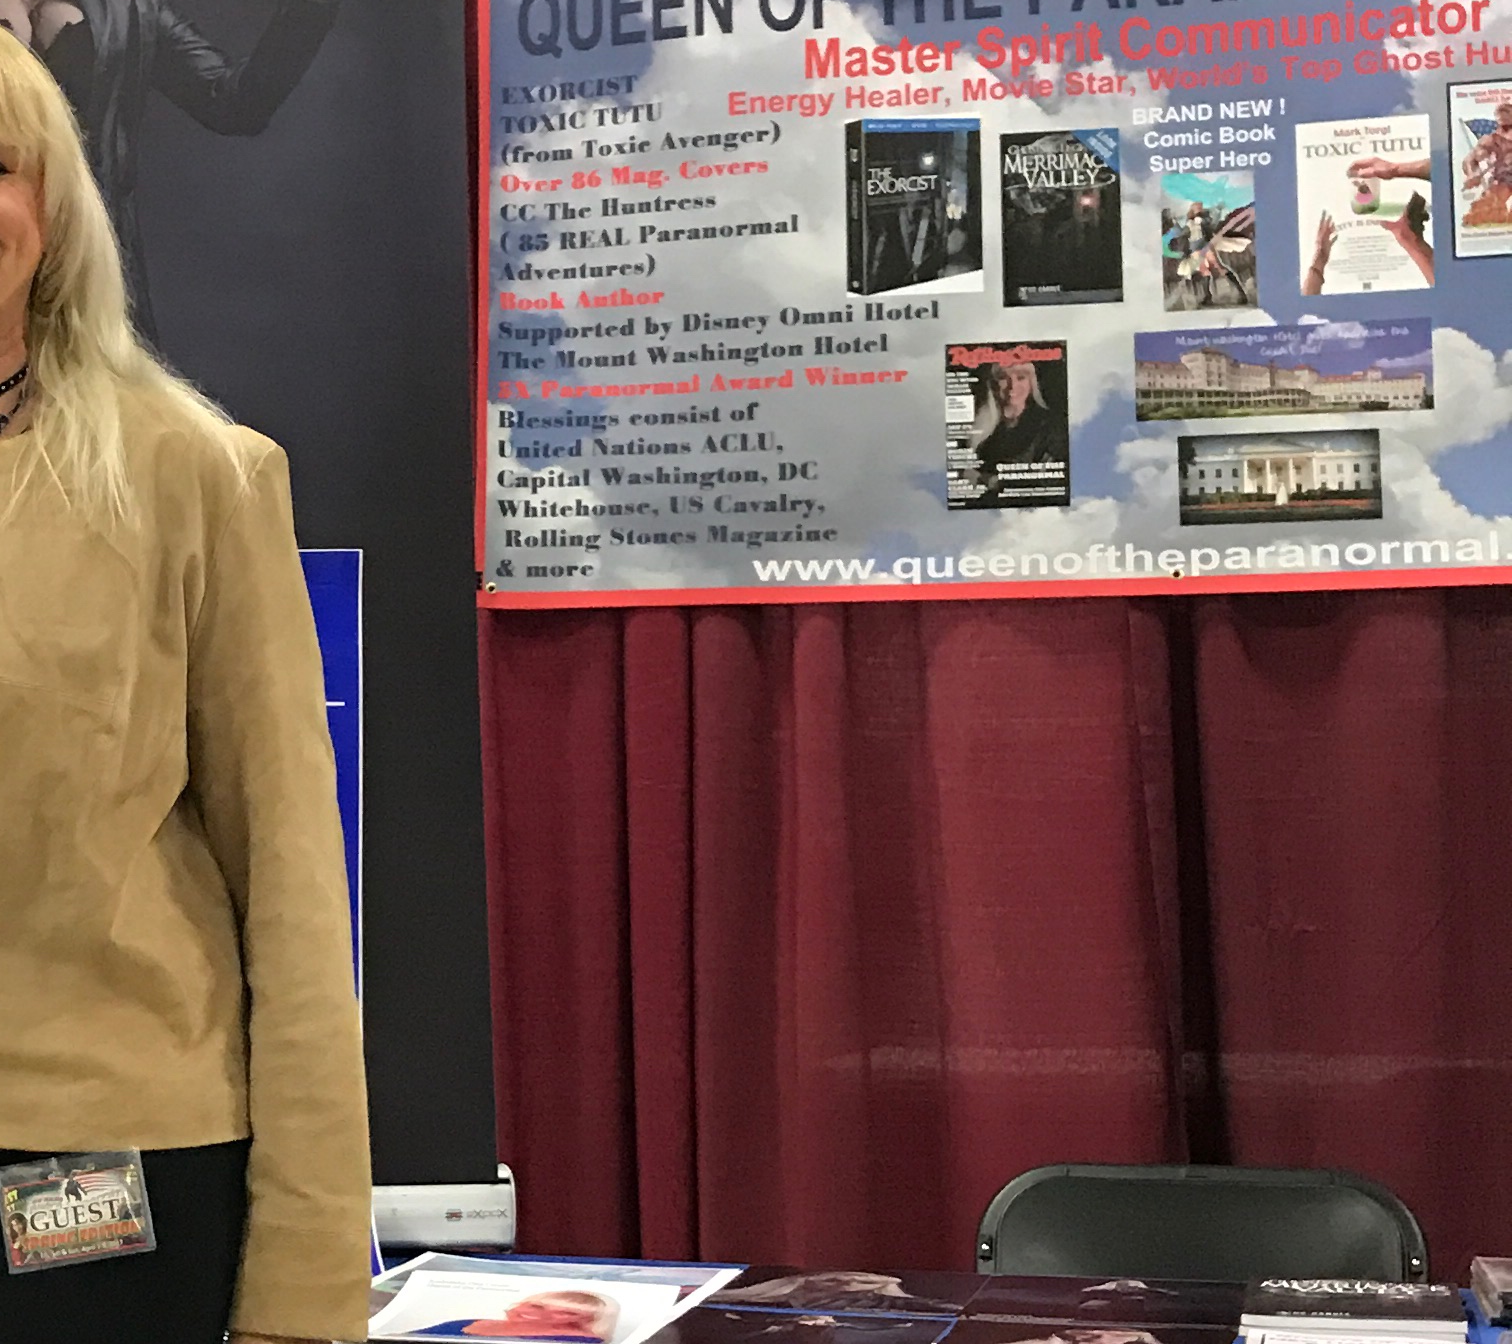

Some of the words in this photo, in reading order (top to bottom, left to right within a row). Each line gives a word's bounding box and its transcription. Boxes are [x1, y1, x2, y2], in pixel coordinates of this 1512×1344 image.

[805, 37, 961, 80] Master
[976, 21, 1103, 75] Spirit
[501, 74, 638, 105] EXORCIST
[728, 91, 834, 118] Energy
[845, 84, 951, 111] Healer,
[962, 77, 1053, 102] Movie
[1066, 71, 1137, 97] Star,
[1147, 59, 1268, 90] World's
[1286, 55, 1343, 86] Top
[1355, 45, 1456, 76] Ghost
[501, 111, 586, 135] TOXIC
[594, 102, 663, 127] TUTU
[1133, 105, 1213, 125] BRAND
[1220, 99, 1273, 119] NEW
[501, 143, 573, 166] (from
[581, 135, 650, 159] Toxic
[660, 120, 781, 152] Avenger)
[1143, 128, 1213, 149] Comic
[1219, 123, 1276, 143] Book
[1303, 142, 1362, 159] TOXIC
[1369, 136, 1423, 154] TUTU
[500, 174, 563, 193] Over
[611, 165, 670, 190] Mag.
[679, 160, 769, 181] Covers
[868, 167, 893, 181] THE
[1150, 152, 1213, 175] Super
[1219, 149, 1272, 168] Hero
[867, 175, 938, 196] EXORCIST
[1022, 168, 1100, 189] VALLEY
[500, 203, 535, 222] CC
[544, 201, 592, 221] The
[600, 195, 717, 218] Huntress
[559, 227, 631, 251] REAL
[639, 214, 800, 245] Paranormal
[498, 253, 657, 282] Adventures)
[499, 291, 565, 311] Book
[576, 288, 666, 309] Author
[498, 315, 635, 346] Supported
[644, 310, 673, 340] by
[682, 308, 771, 335] Disney
[779, 304, 854, 326] Omni
[864, 300, 939, 323] Hotel
[498, 351, 546, 371] The
[555, 347, 637, 370] Mount
[647, 339, 804, 366] Washington
[813, 334, 888, 355] Hotel
[541, 373, 700, 399] Paranormal
[709, 370, 794, 393] Award
[803, 367, 908, 388] Winner
[498, 408, 620, 432] Blessings
[629, 405, 722, 426] consist
[730, 402, 760, 423] of
[498, 438, 583, 459] United
[591, 436, 691, 457] Nations
[700, 432, 785, 456] ACLU,
[497, 467, 591, 495] Capital
[601, 464, 769, 491] Washington,
[777, 461, 820, 482] DC
[497, 497, 660, 521] Whitehouse,
[668, 496, 704, 515] US
[713, 494, 826, 518] Cavalry,
[504, 526, 602, 552] Rolling
[610, 526, 697, 547] Stones
[706, 523, 839, 549] Magazine
[495, 559, 515, 579] &
[526, 561, 595, 579] more
[29, 1198, 121, 1232] GUEST
